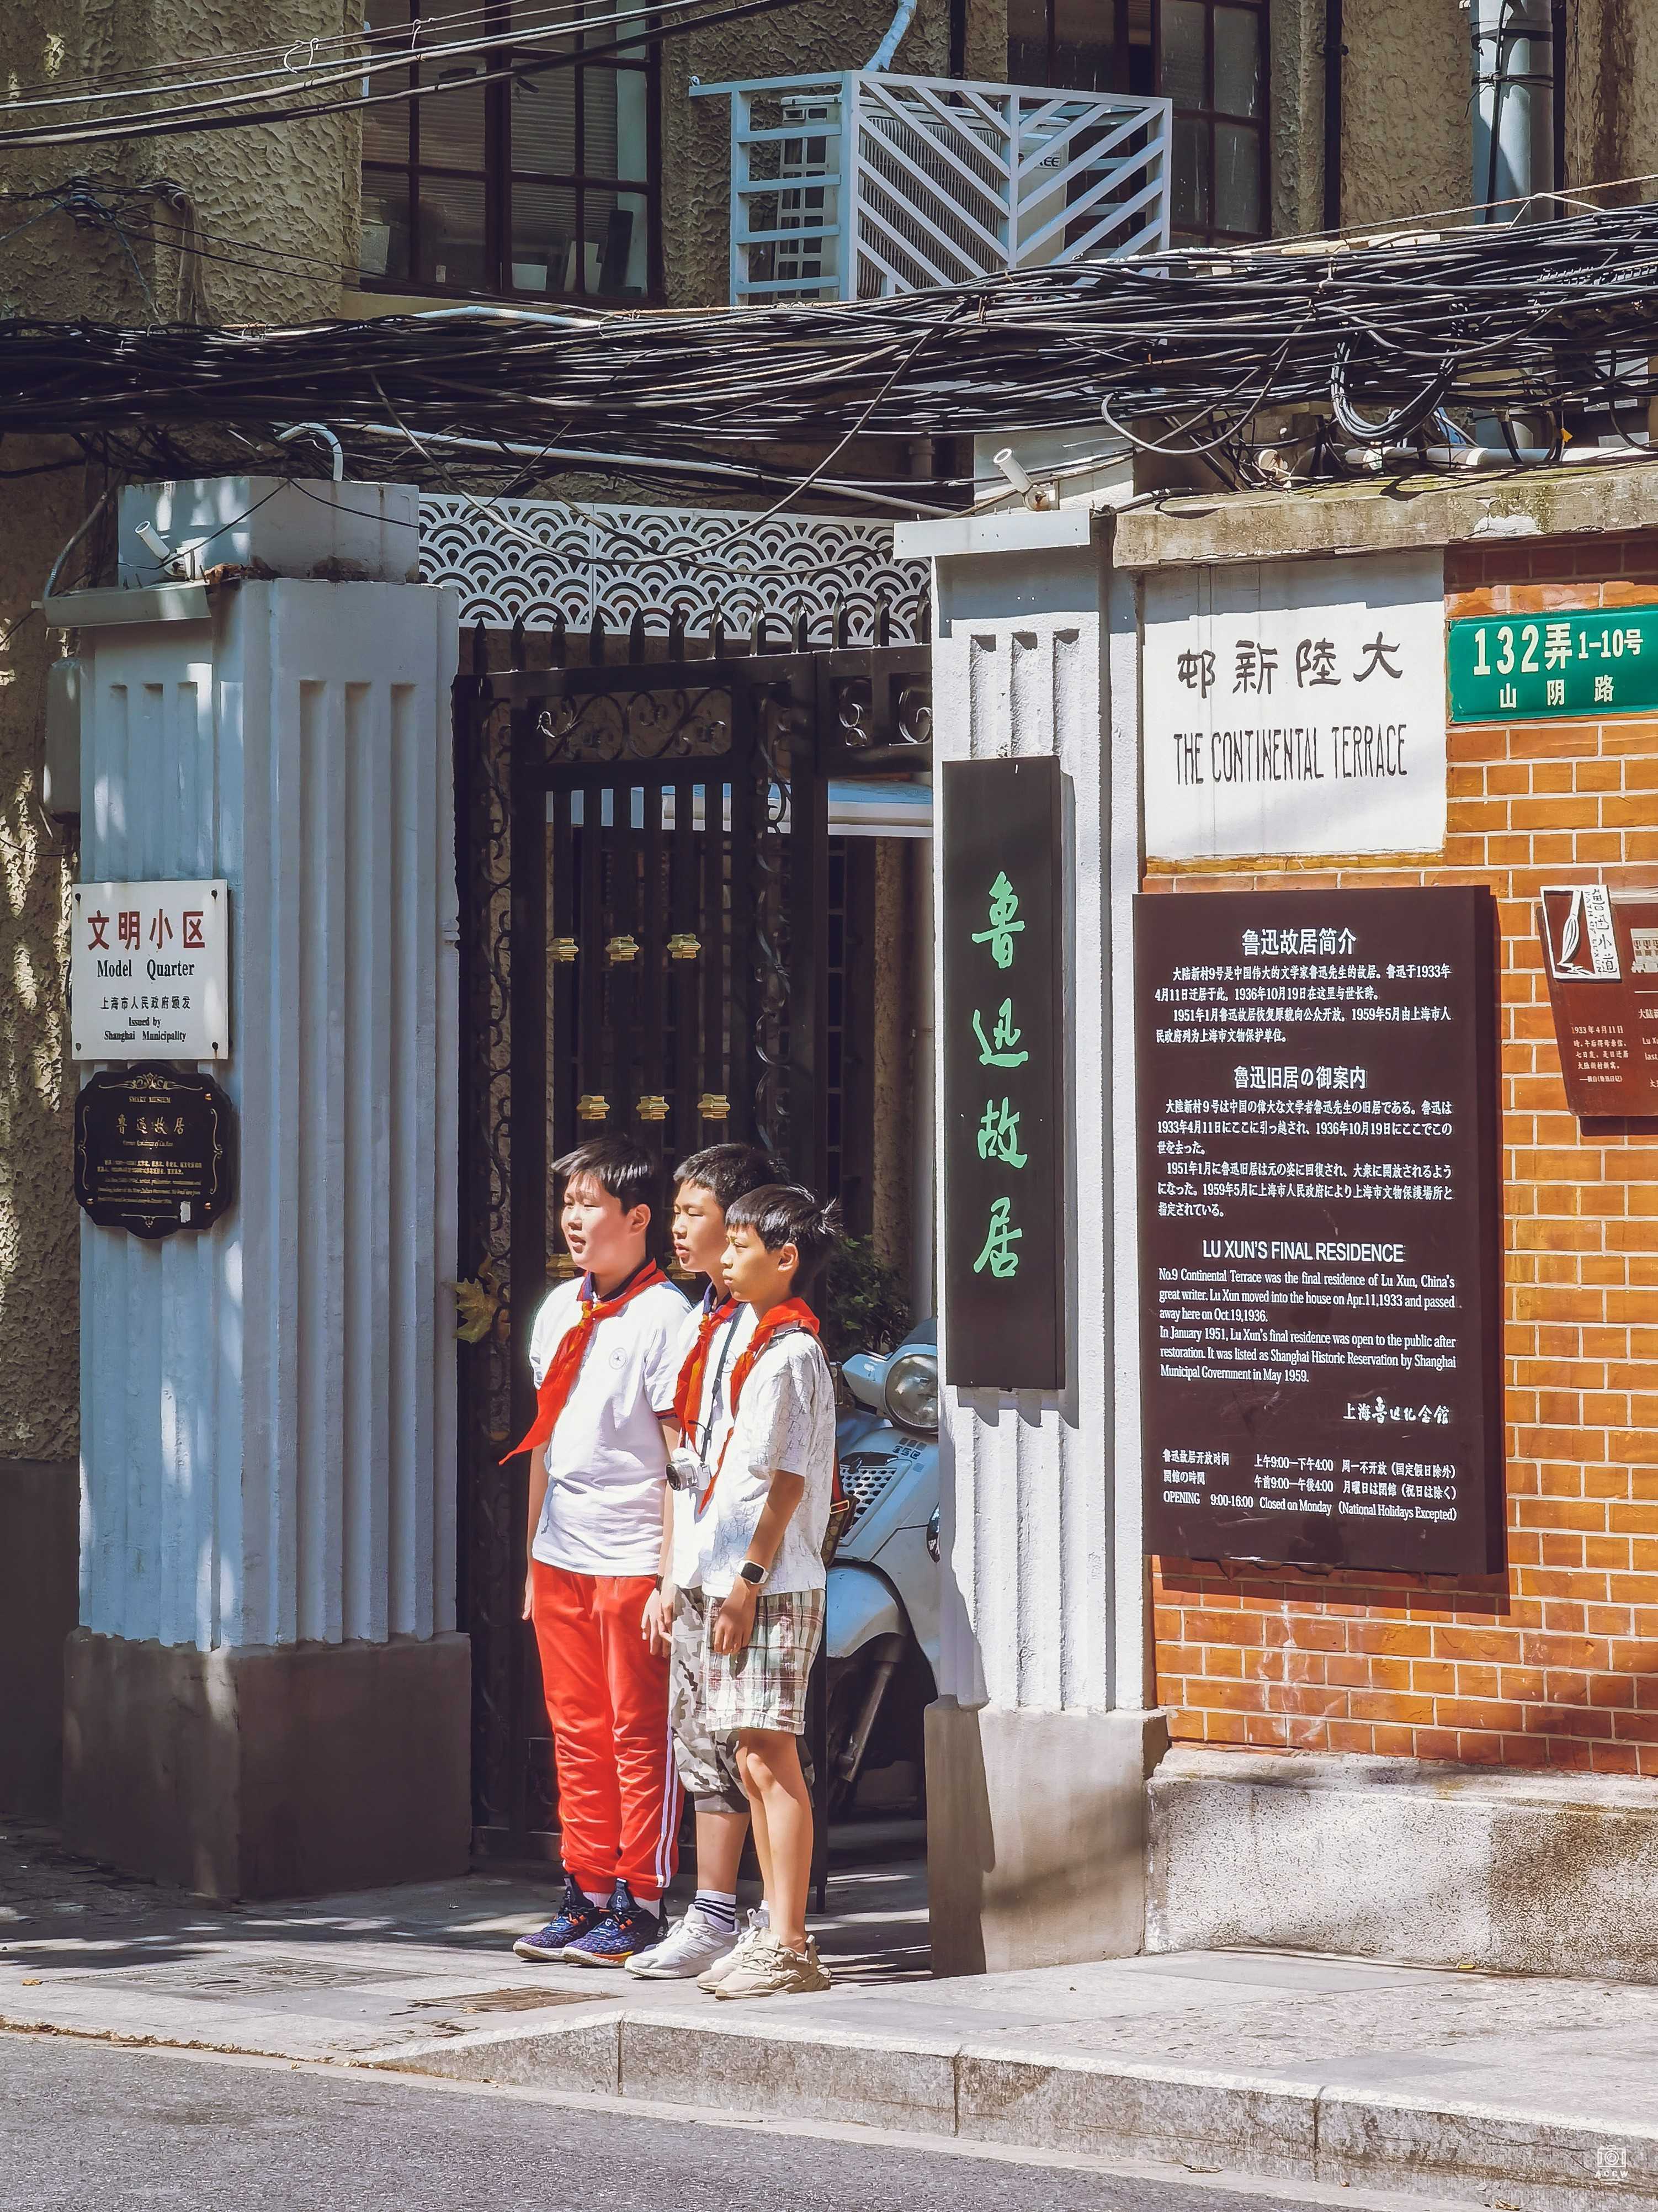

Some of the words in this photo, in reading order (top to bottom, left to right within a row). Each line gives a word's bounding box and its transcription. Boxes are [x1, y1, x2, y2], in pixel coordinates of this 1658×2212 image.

[1500, 675, 1614, 709] 山阴路
[1173, 732, 1204, 785] THE
[1211, 726, 1325, 783] CONTINENTAL
[1331, 724, 1408, 779] TERRACE
[88, 909, 205, 951] 文明小区
[1242, 927, 1357, 956] 鲁迅故居简介
[97, 959, 132, 977] Model
[147, 959, 194, 980] Quarter
[100, 996, 190, 1010] 上海市人民政府颁发
[152, 1017, 161, 1028] by
[104, 1031, 135, 1042] Shanghai
[142, 1031, 187, 1043] Municipality
[971, 871, 1029, 1278] 鲁迅故居
[1156, 1139, 1205, 1155] 世を去った。
[1157, 1201, 1224, 1217] 指定されている。
[1203, 1239, 1221, 1258] LU
[1224, 1240, 1268, 1259] XUN'S
[1271, 1241, 1314, 1260] FINAL
[1315, 1242, 1405, 1263] RESIDENCE
[1159, 1267, 1178, 1281] No.9
[1181, 1268, 1227, 1282] Continental
[1229, 1269, 1262, 1283] Terrace
[1264, 1274, 1282, 1283] was
[1284, 1271, 1299, 1284] the
[1301, 1271, 1321, 1285] final
[1324, 1272, 1365, 1286] residence
[1368, 1273, 1379, 1286] of
[1380, 1274, 1394, 1287] Lu
[1396, 1274, 1418, 1288] Xun,
[1421, 1274, 1455, 1288] China's
[1159, 1289, 1181, 1303] great
[1181, 1290, 1209, 1301] writer.
[1209, 1288, 1221, 1301] Lu
[1221, 1288, 1241, 1302] Xun
[1241, 1290, 1269, 1303] moved
[1271, 1291, 1288, 1303] into
[1289, 1291, 1304, 1304] the
[1305, 1291, 1332, 1304] house
[1332, 1295, 1346, 1305] on
[1346, 1292, 1403, 1309] Apr.11,1933
[1404, 1294, 1422, 1307] and
[1423, 1295, 1455, 1311] passed
[1159, 1309, 1181, 1323] away
[1181, 1307, 1201, 1320] here
[1201, 1311, 1214, 1320] on
[1214, 1308, 1268, 1323] Oct.19,1936.
[1159, 1325, 1169, 1338] In
[1170, 1325, 1203, 1343] January
[1204, 1327, 1229, 1341] 1951,
[1230, 1328, 1242, 1341] Lu
[1242, 1328, 1268, 1341] Xun's
[1269, 1329, 1289, 1343] final
[1290, 1330, 1331, 1344] residence
[1332, 1334, 1350, 1345] was
[1351, 1335, 1374, 1349] open
[1375, 1334, 1385, 1346] to
[1386, 1333, 1402, 1346] the
[1404, 1334, 1432, 1350] public
[1433, 1334, 1457, 1348] after
[1160, 1346, 1207, 1359] restoration.
[1207, 1346, 1215, 1359] It
[1215, 1350, 1233, 1360] was
[1234, 1348, 1257, 1361] listed
[1258, 1351, 1269, 1361] as
[1271, 1349, 1310, 1366] Shanghai
[1311, 1350, 1346, 1364] Historic
[1347, 1351, 1399, 1366] Reservation
[1400, 1353, 1413, 1370] by
[1414, 1354, 1457, 1371] Shanghai
[1160, 1364, 1201, 1381] Municipal
[1201, 1365, 1252, 1380] Government
[1252, 1368, 1262, 1381] in
[1262, 1368, 1282, 1385] May
[1284, 1369, 1309, 1382] 1959.
[1162, 1448, 1229, 1466] 鲁迅故居开放时间
[1163, 1490, 1200, 1505] OPENING
[1210, 1494, 1254, 1508] 9:00-16:00
[1259, 1496, 1287, 1510] Closed
[1287, 1502, 1299, 1511] on
[1298, 1499, 1332, 1516] Monday
[1338, 1500, 1377, 1516] (National
[1377, 1504, 1414, 1521] Holidays
[1414, 1507, 1457, 1523] Excepted)
